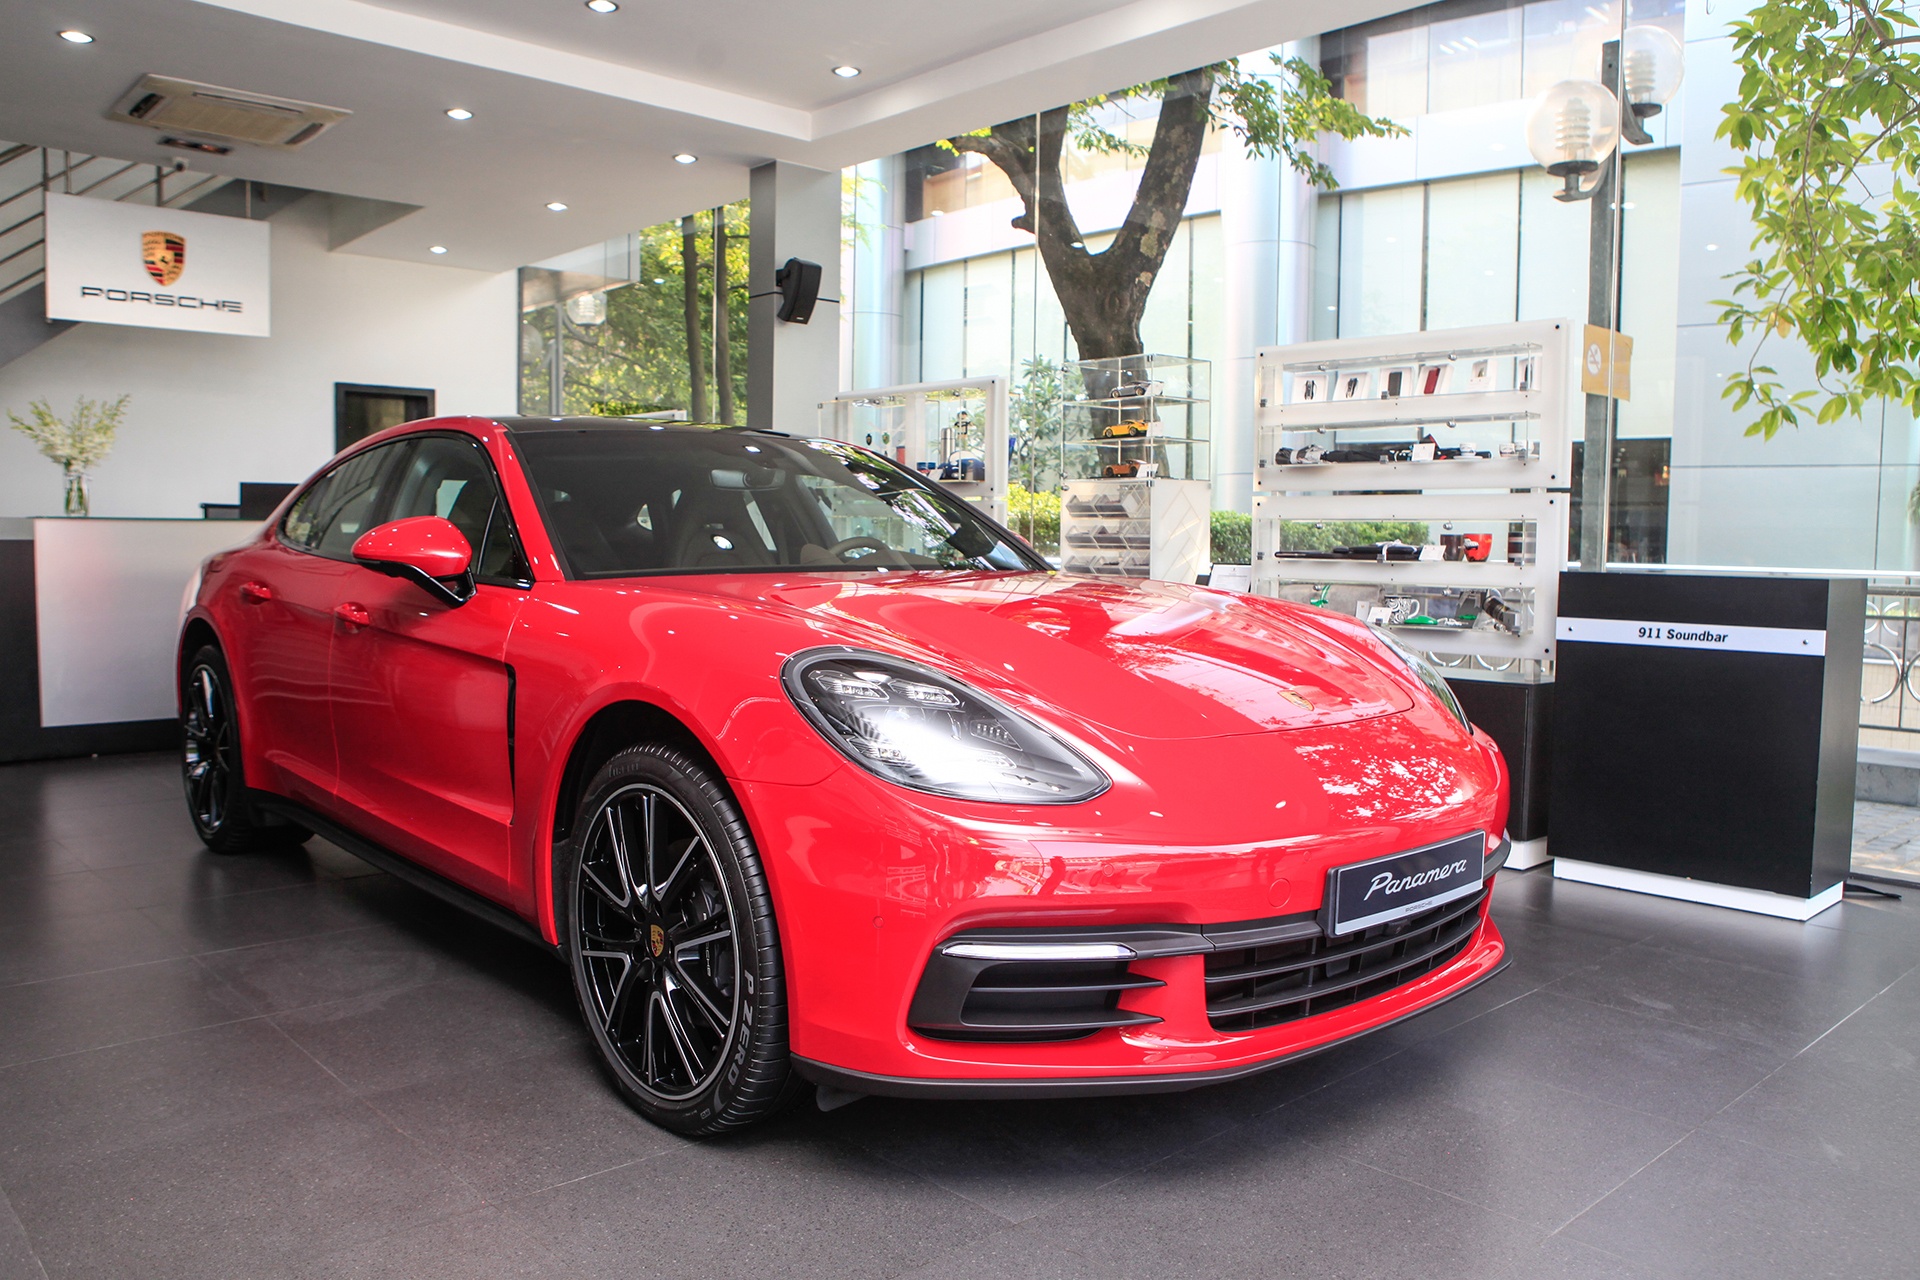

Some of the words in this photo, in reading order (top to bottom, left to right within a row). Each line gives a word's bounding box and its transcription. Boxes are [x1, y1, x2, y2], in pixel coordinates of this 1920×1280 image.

[80, 286, 243, 313] PORSCHE
[1638, 626, 1661, 639] 911
[1666, 628, 1728, 643] Soundbar
[1363, 859, 1467, 901] Panamera
[744, 969, 755, 995] P
[728, 1000, 754, 1087] ZERO
